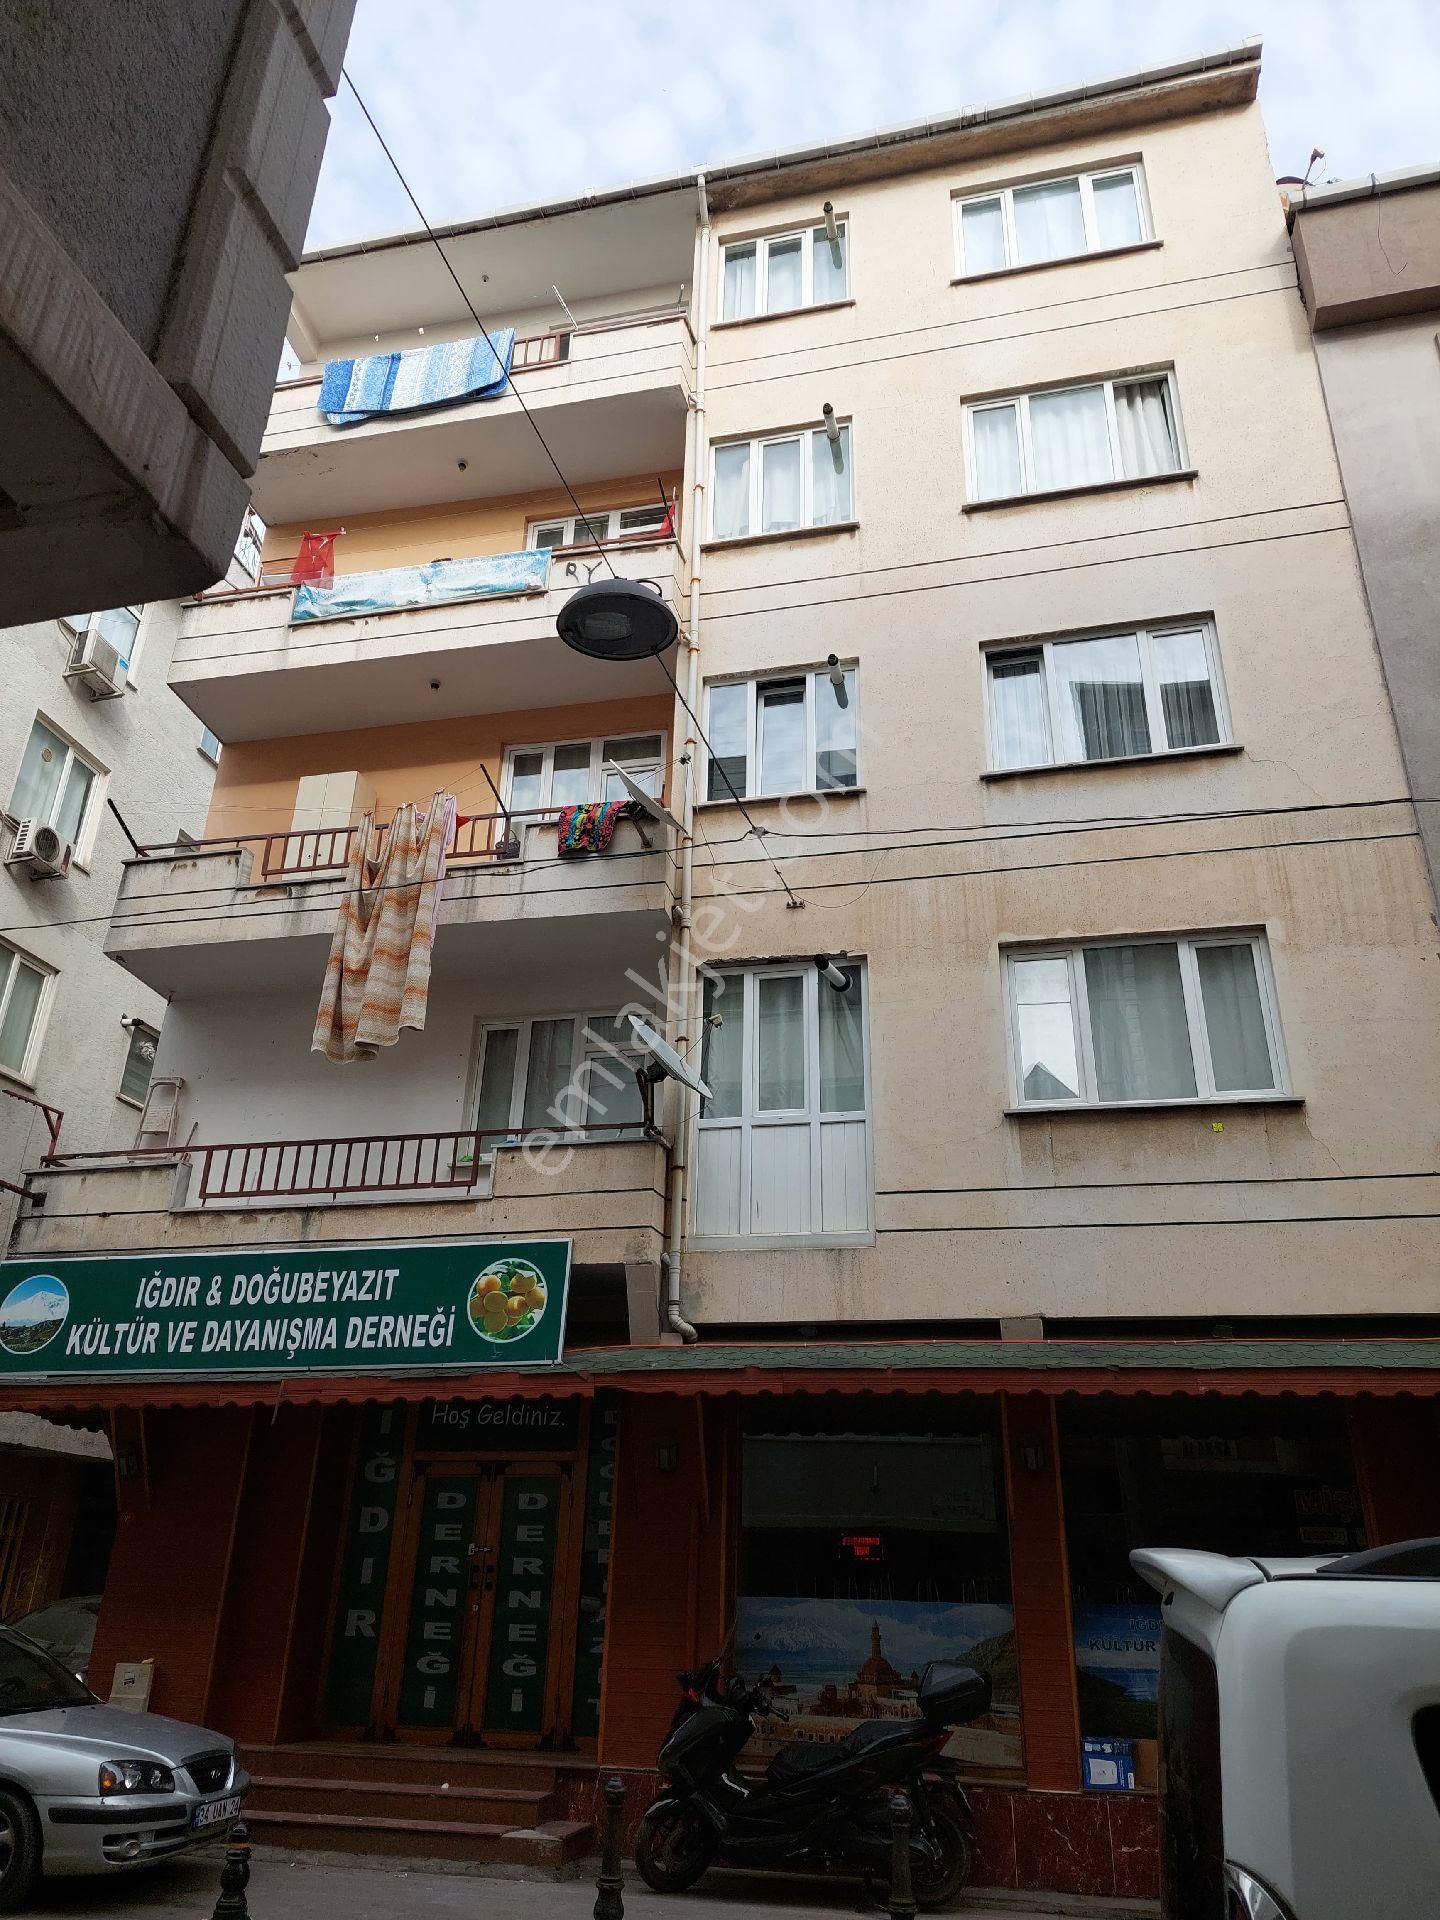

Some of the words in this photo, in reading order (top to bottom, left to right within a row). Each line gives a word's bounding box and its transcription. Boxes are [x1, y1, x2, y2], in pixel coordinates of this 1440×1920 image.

[136, 1270, 199, 1309] IĞDIR
[206, 1275, 223, 1306] &
[229, 1266, 400, 1307] DOĞUBEYAZIT
[65, 1316, 160, 1356] KÜLTÜR
[167, 1322, 195, 1353] VE
[200, 1317, 338, 1360] DAYANIŞMA
[345, 1305, 456, 1349] DERNEĞİ
[432, 1402, 471, 1429] Hoş
[477, 1403, 566, 1427] Geldiniz.
[416, 1491, 467, 1710] DERNEĞİ
[502, 1492, 549, 1713] DERNEĞİ
